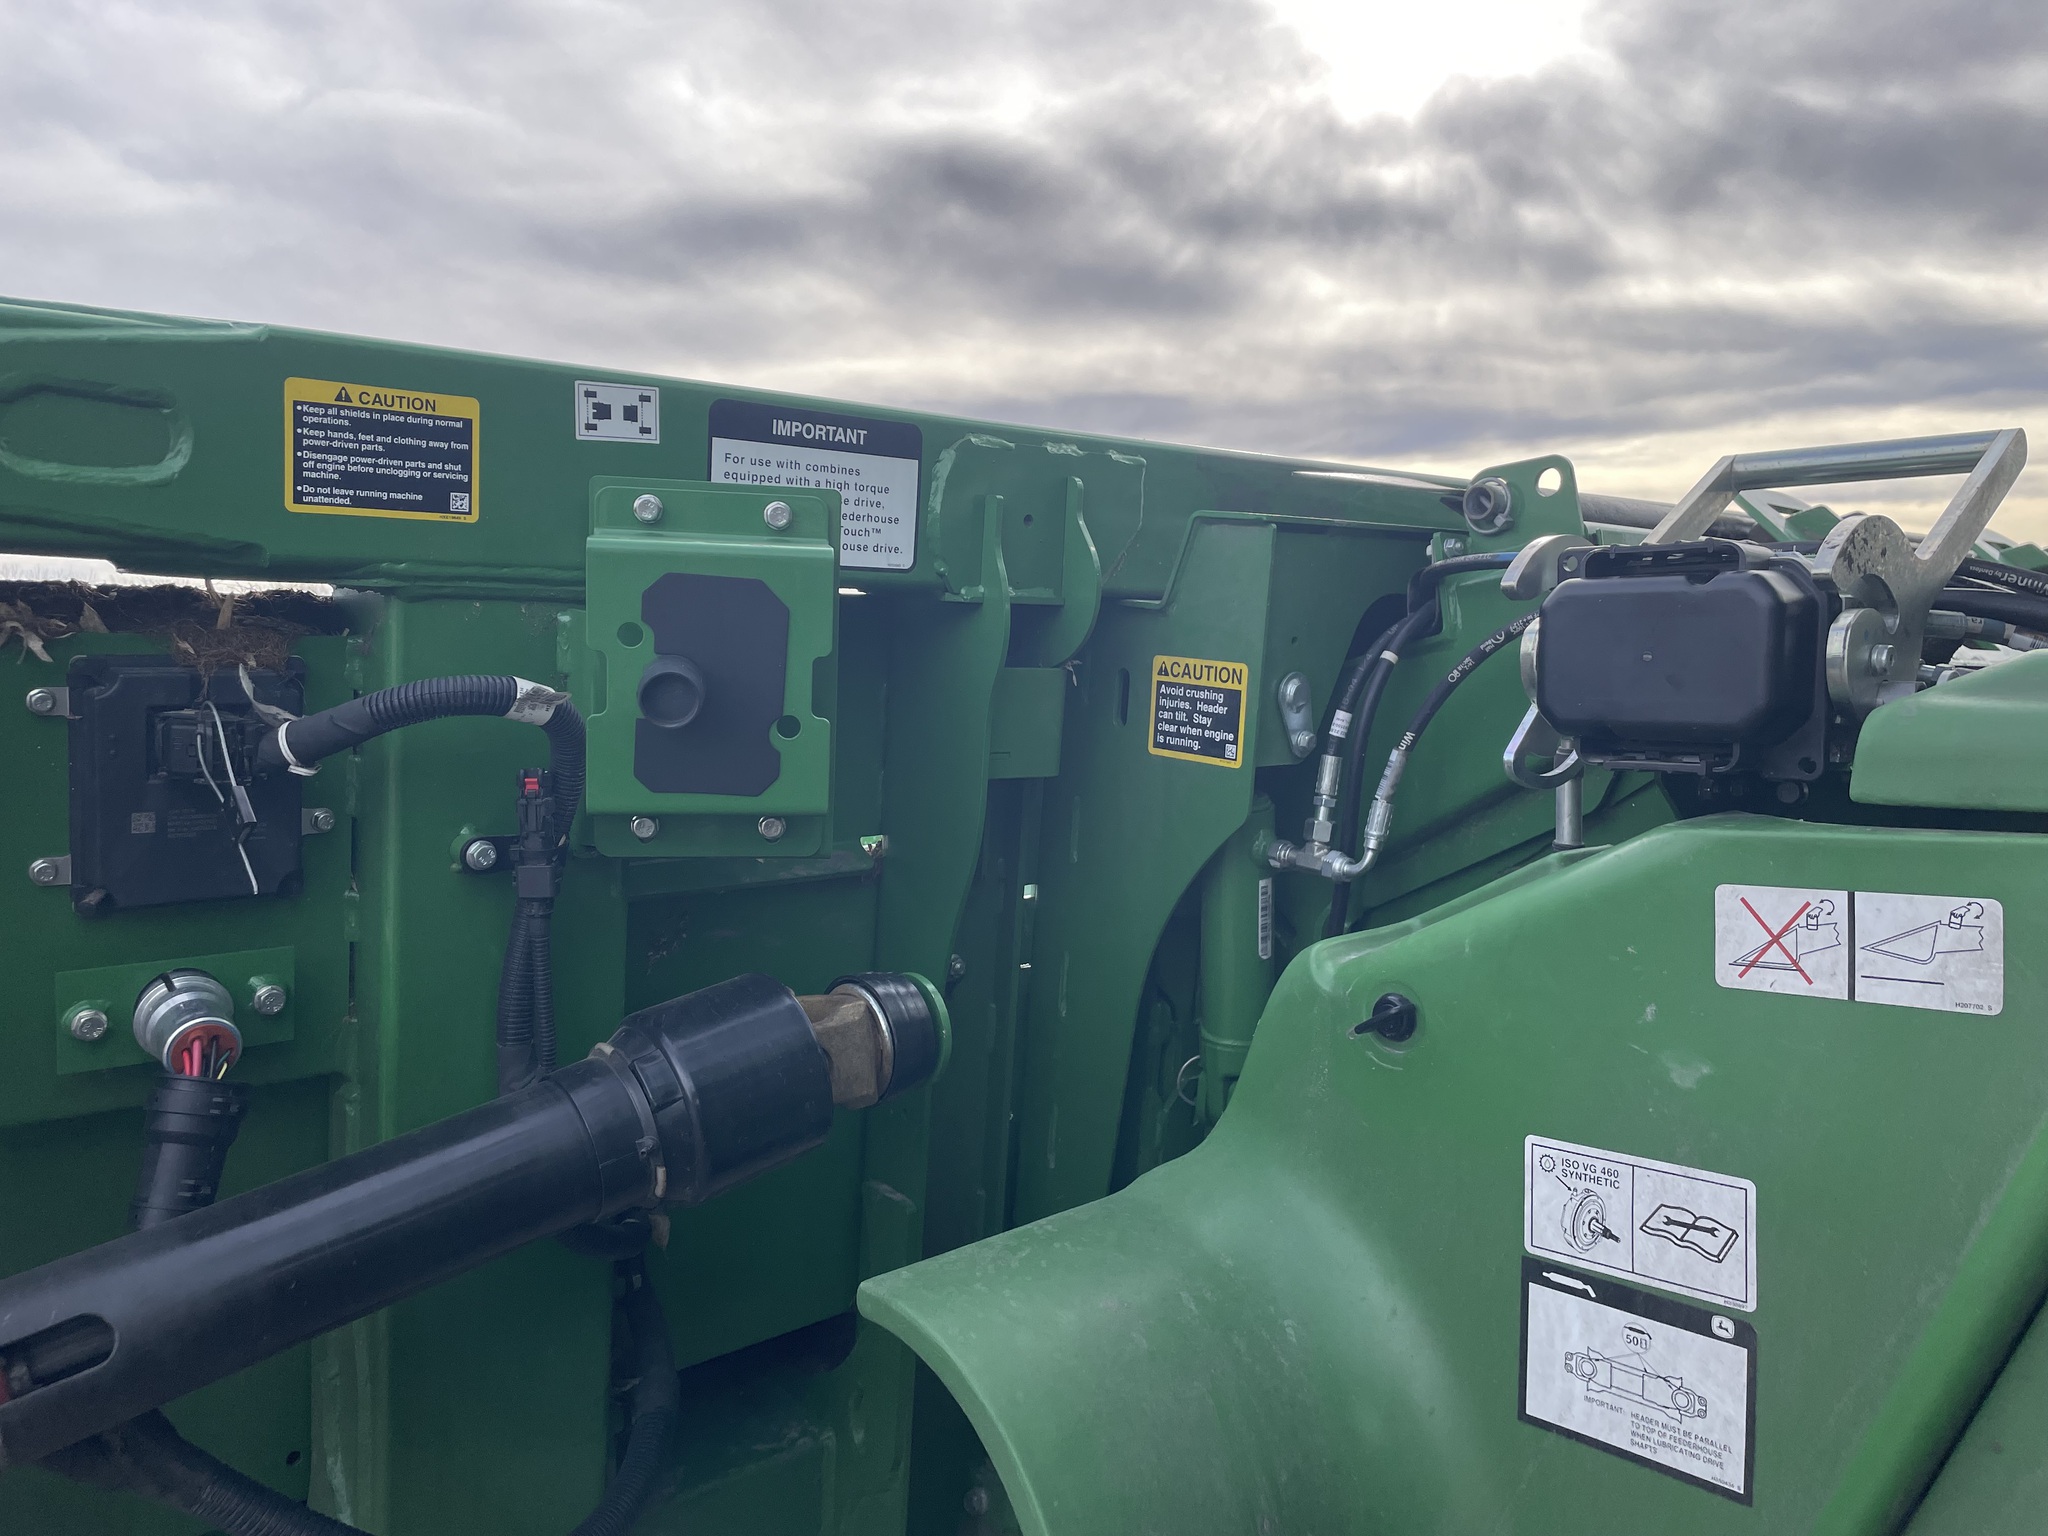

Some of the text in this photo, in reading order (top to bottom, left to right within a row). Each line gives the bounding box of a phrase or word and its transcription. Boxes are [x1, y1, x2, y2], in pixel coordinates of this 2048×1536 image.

[359, 391, 436, 412] CAUTION
[303, 405, 462, 428] Keep all shields in place during normal
[303, 415, 351, 426] operations.
[303, 428, 325, 438] Keep
[358, 432, 374, 441] feet
[376, 434, 391, 443] and
[394, 435, 426, 448] clothing
[428, 440, 448, 450] away
[451, 441, 468, 450] from
[772, 419, 867, 444] IMPORTANT
[303, 438, 385, 452] power-driven parts.
[303, 451, 461, 471] Disengage power-driven parts and shut
[303, 461, 314, 469] off
[317, 463, 345, 472] engine
[348, 465, 373, 473] before
[376, 466, 420, 478] unclogging
[433, 471, 468, 481] servicing
[725, 453, 860, 476] For use with combines
[303, 471, 341, 480] machine.
[724, 471, 890, 494] equipped with a high torque
[303, 485, 314, 493] Do
[333, 487, 354, 495] leave
[356, 490, 387, 499] running
[389, 492, 423, 501] machine
[303, 495, 351, 505] unattended.
[842, 512, 899, 524] ederhouse
[873, 543, 903, 554] drive.
[1170, 662, 1242, 684] CAUTION
[1160, 684, 1223, 703] Avoid crushing
[1159, 697, 1228, 714] injuries. Header
[1159, 710, 1212, 727] can tilt. Stay
[1157, 733, 1200, 750] is running.
[1158, 722, 1234, 741] clear when engine
[1562, 1158, 1619, 1178] ISO VG 460
[1562, 1169, 1619, 1189] SYNTHETIC
[1630, 1411, 1732, 1454] HEADER MUST BE PARALLEL
[1631, 1421, 1722, 1459] TO TOP OF FEEDERHOUSE
[1630, 1438, 1658, 1454] SHAFTS
[1630, 1430, 1724, 1470] WHEN LUBRICATING DRIVE
